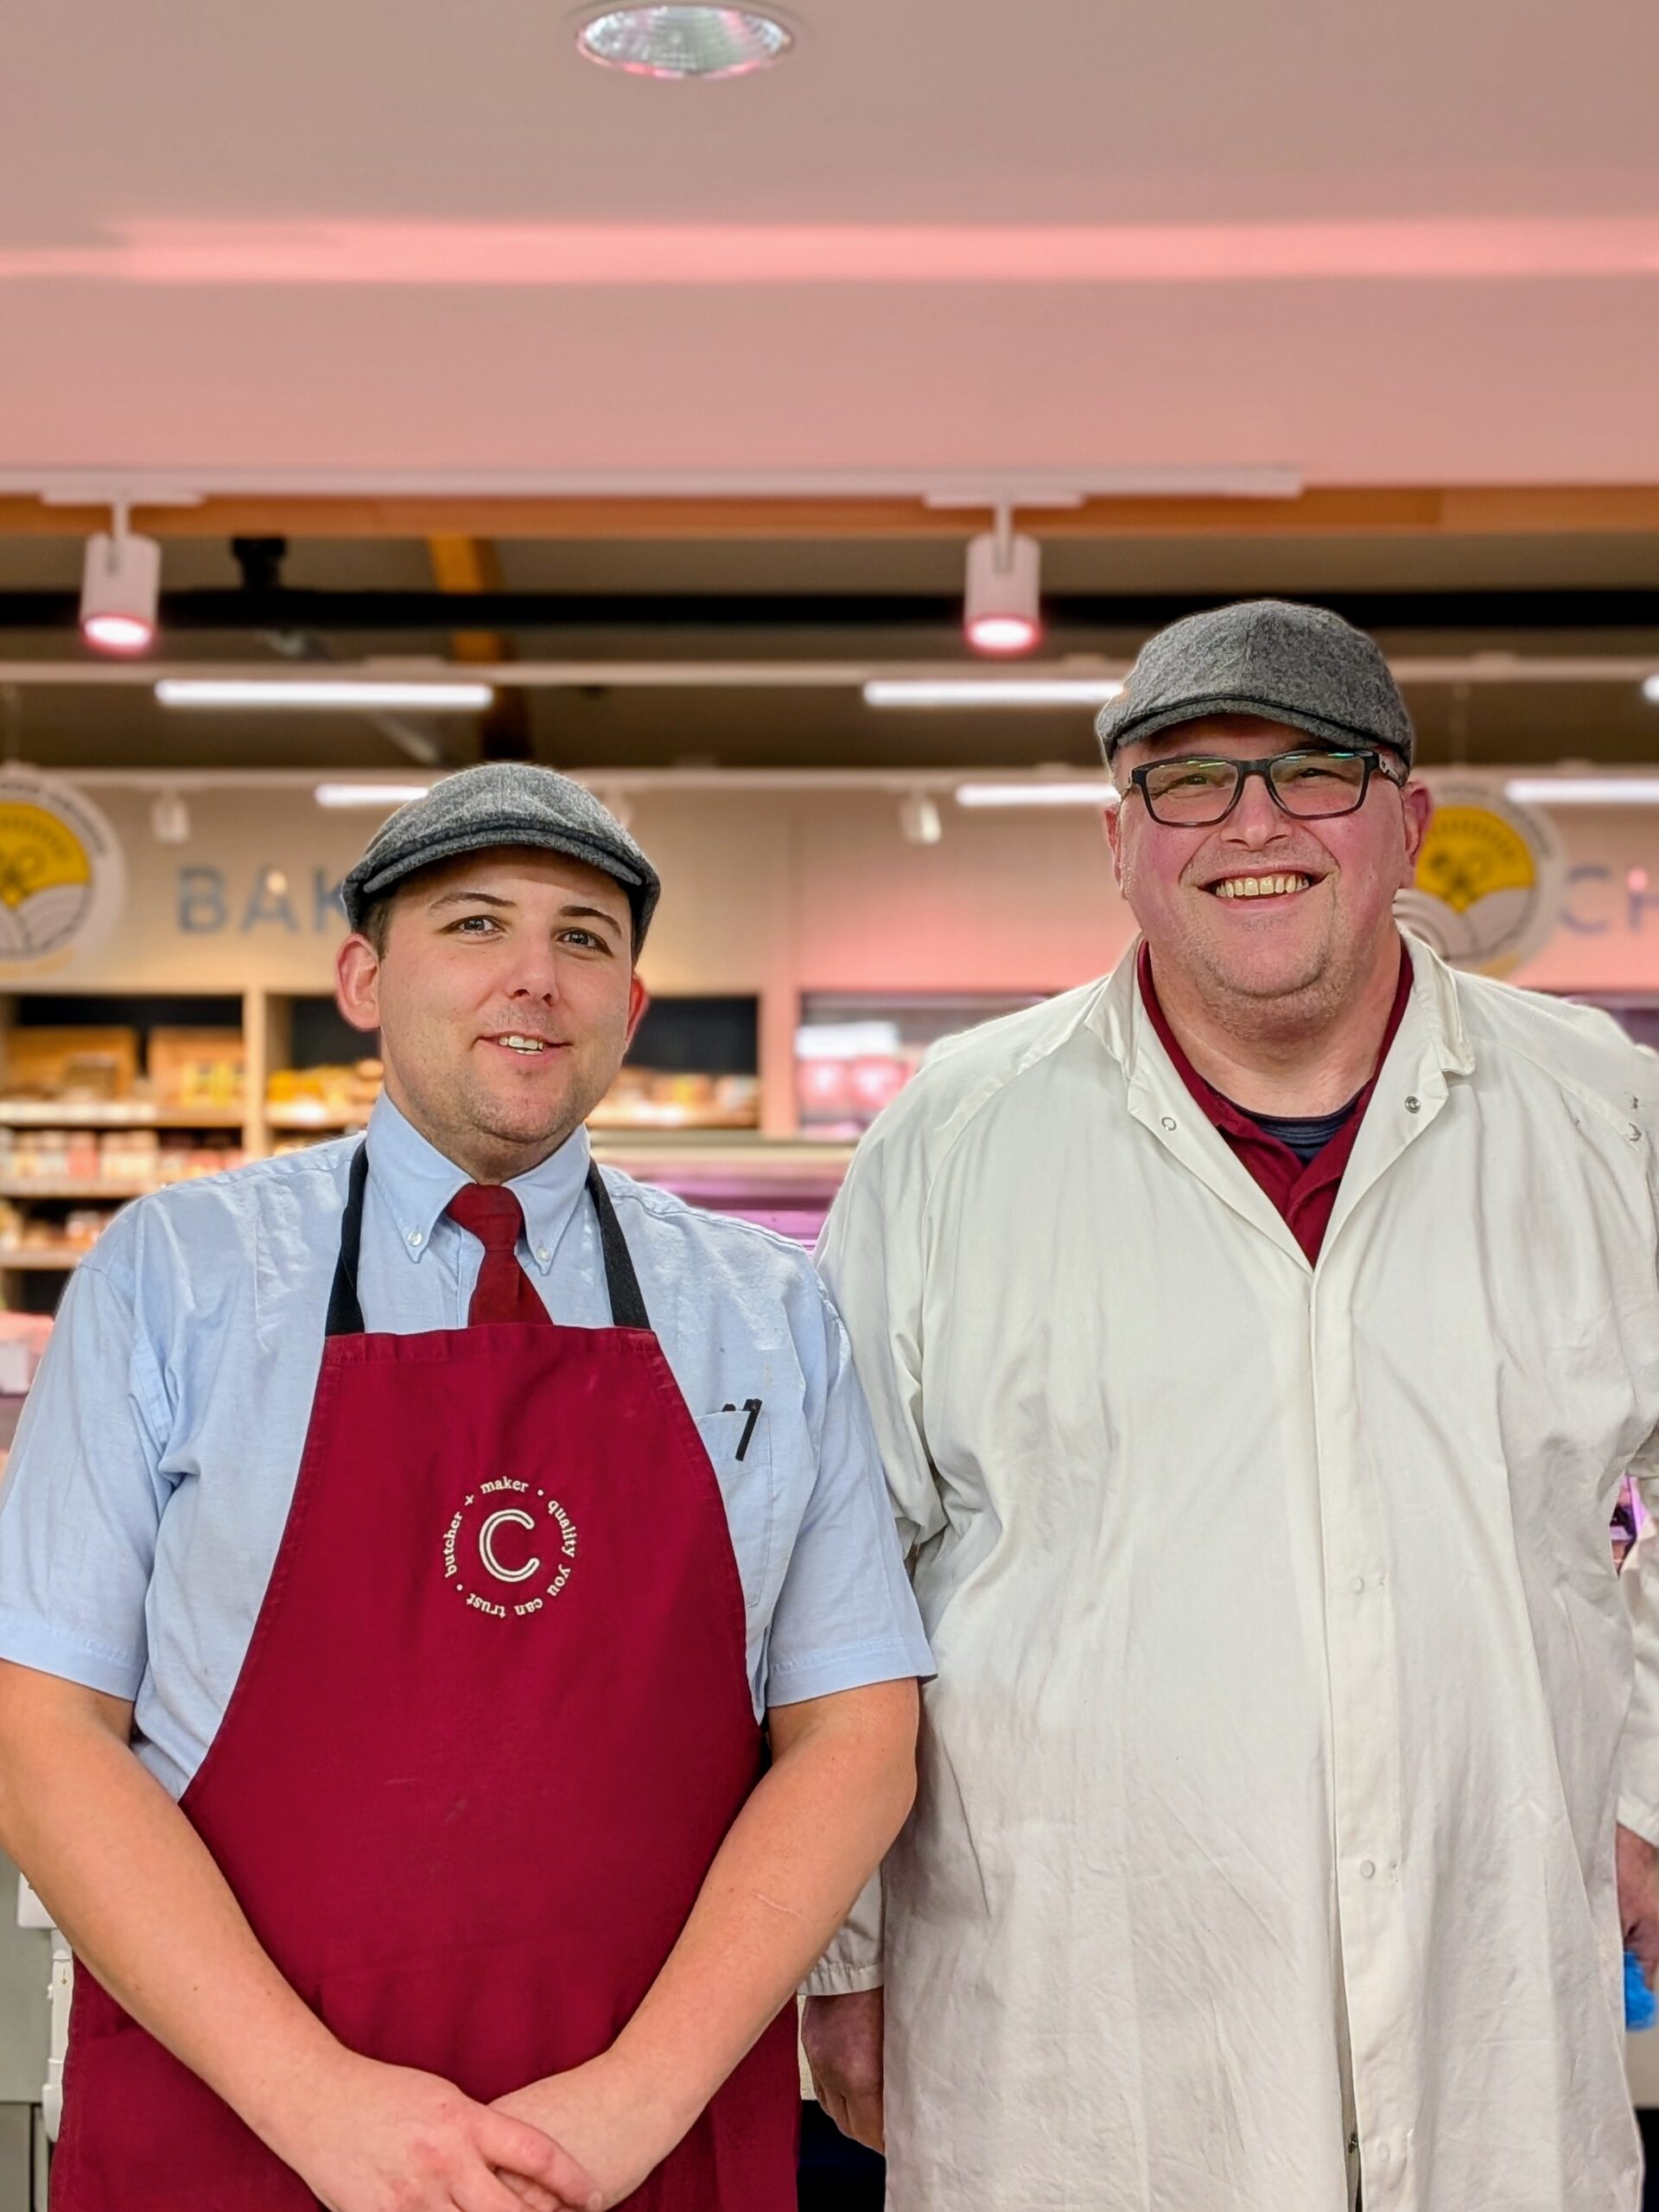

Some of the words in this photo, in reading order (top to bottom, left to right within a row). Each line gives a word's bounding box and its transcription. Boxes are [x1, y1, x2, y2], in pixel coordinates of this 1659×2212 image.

[442, 1511, 463, 1578] butcher
[480, 1476, 529, 1495] maker
[479, 1509, 540, 1582] C
[547, 1500, 577, 1558] quality
[546, 1564, 571, 1597] you
[466, 1592, 506, 1618] trust
[513, 1598, 543, 1616] can
